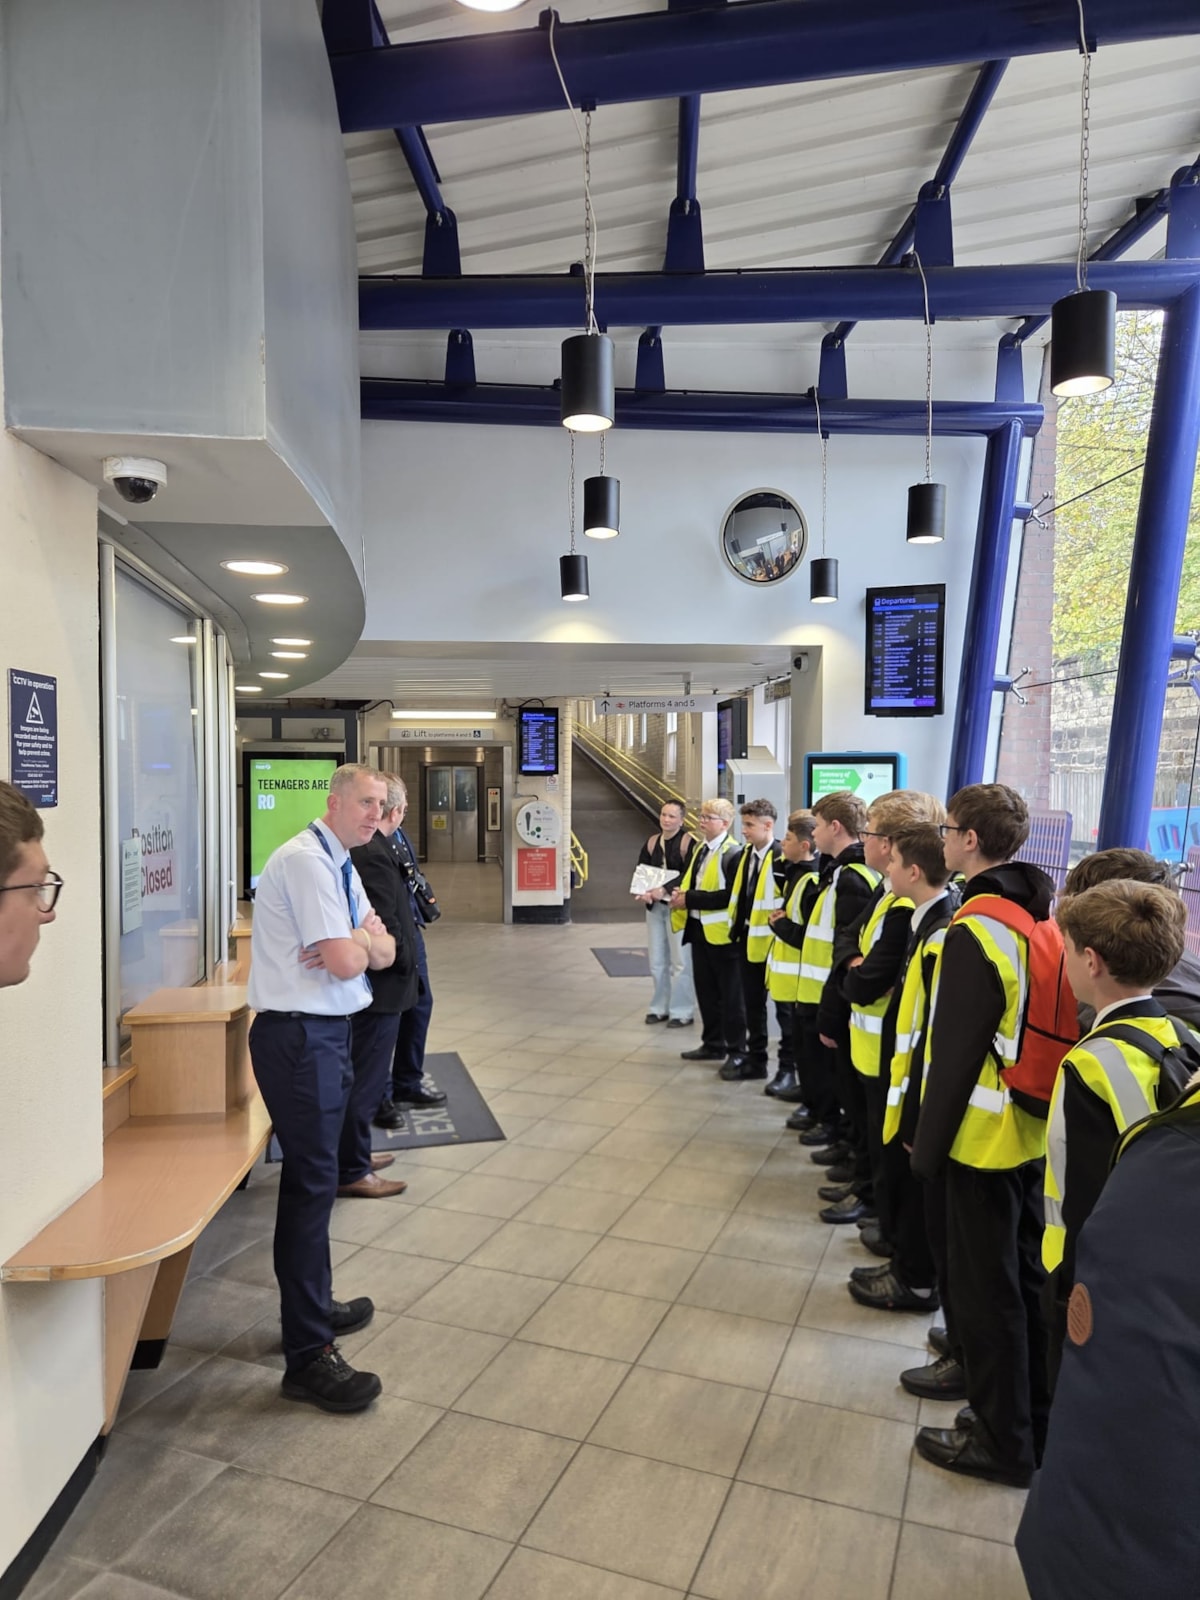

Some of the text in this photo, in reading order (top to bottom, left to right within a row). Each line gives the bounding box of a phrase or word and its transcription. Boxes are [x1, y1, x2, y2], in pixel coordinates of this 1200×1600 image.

[13, 676, 54, 690] CCTV in operation
[629, 700, 666, 708] Platforms
[690, 699, 695, 707] 5
[413, 730, 428, 738] Lift
[257, 779, 329, 790] TEENAGERS ARE
[257, 794, 275, 810] RO
